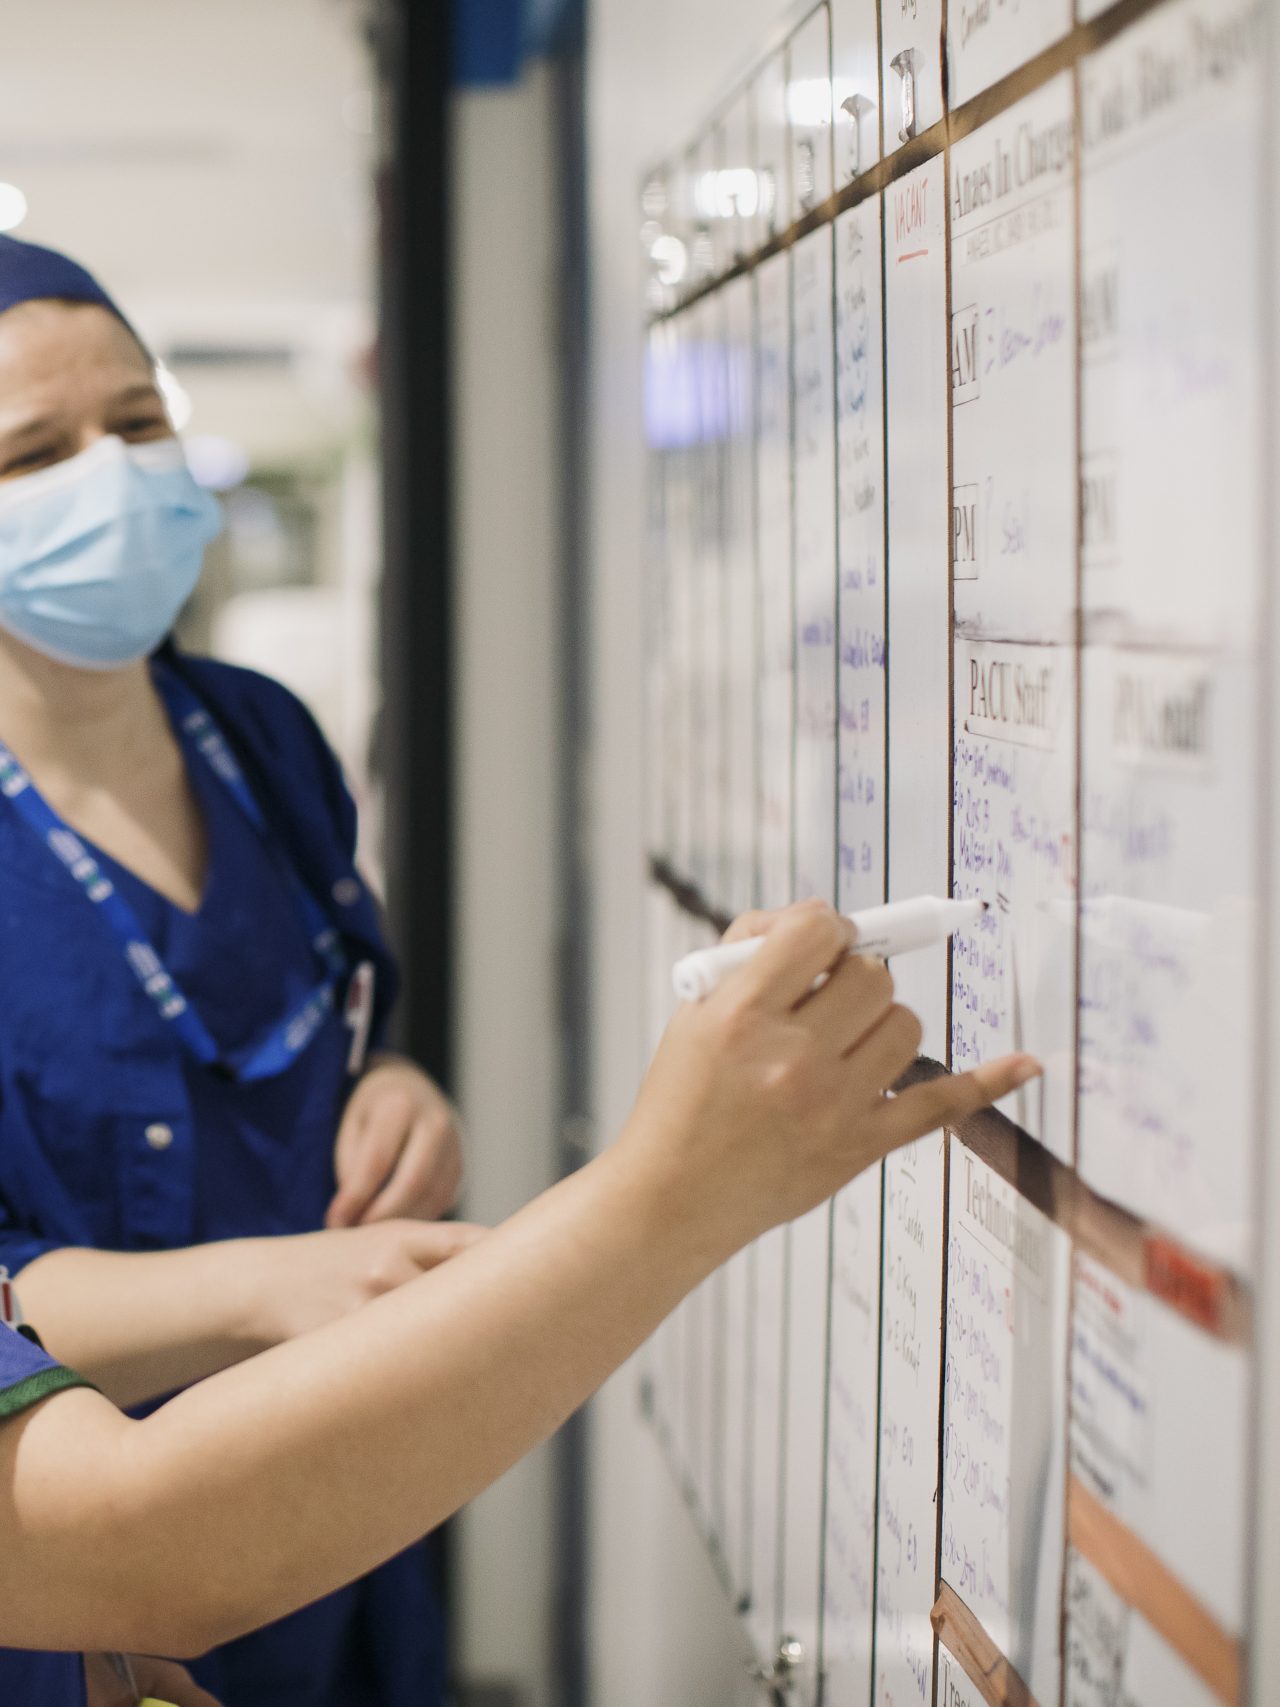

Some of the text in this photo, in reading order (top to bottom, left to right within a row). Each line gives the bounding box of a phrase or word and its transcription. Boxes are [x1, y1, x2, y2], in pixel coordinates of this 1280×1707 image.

[894, 177, 929, 244] VACANT
[953, 318, 977, 389] AM
[953, 503, 977, 562] PM
[970, 658, 1051, 728] PACU Staff
